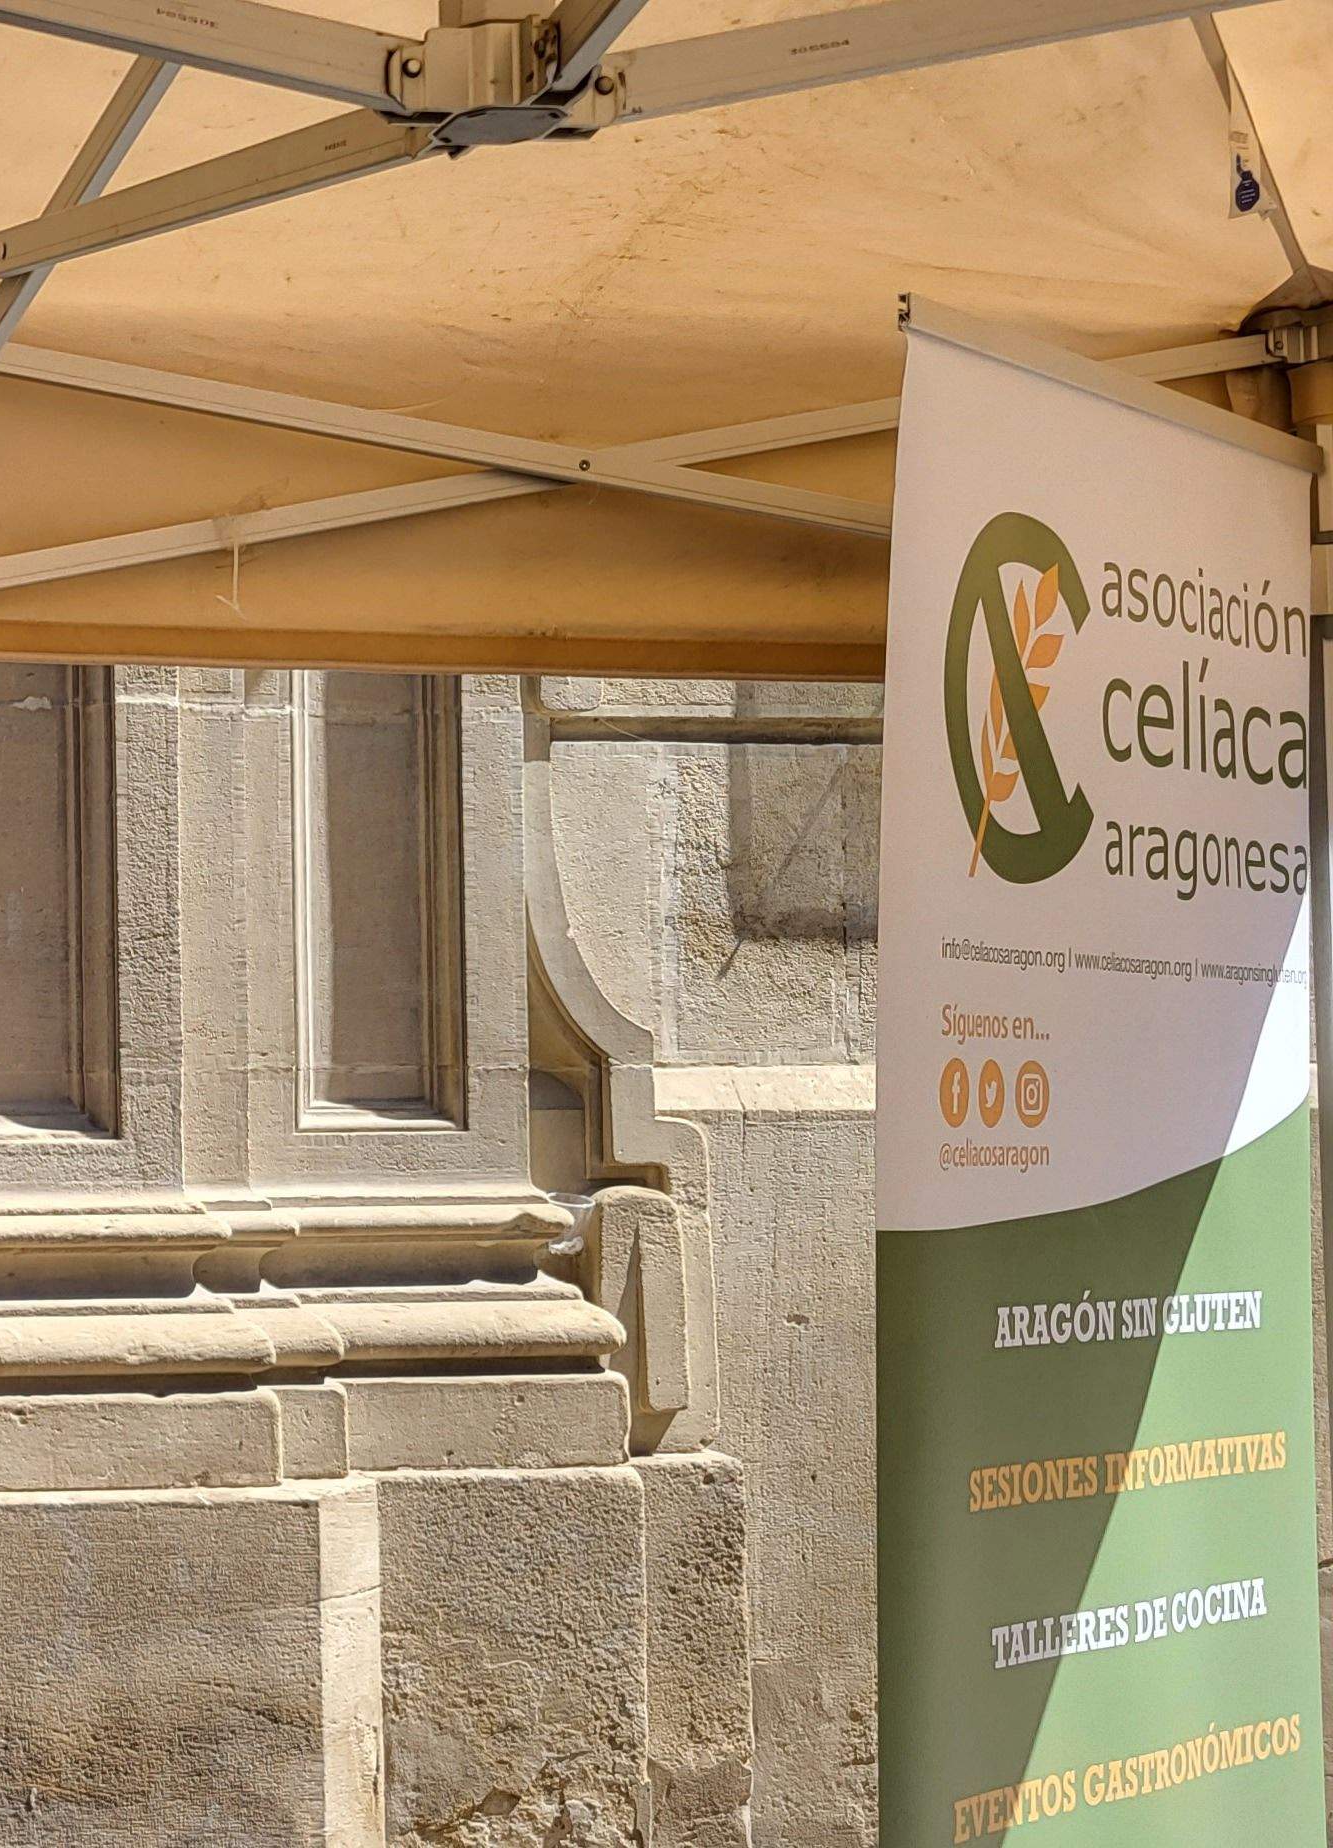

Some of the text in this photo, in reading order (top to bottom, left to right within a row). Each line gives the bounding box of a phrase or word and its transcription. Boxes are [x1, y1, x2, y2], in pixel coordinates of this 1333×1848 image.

[1102, 562, 1306, 657] asociación
[1102, 656, 1307, 789] celíaca
[1105, 820, 1308, 901] aragonesa
[941, 936, 1065, 973] info@celiacosaragon.org
[941, 1003, 1050, 1045] Síguenos en...
[939, 1137, 1050, 1173] @celiacosaragon
[994, 1290, 1262, 1348] ARAGÓN SIN GLUTEN
[969, 1431, 1286, 1512] SESIONES INFORMATIVAS
[991, 1577, 1267, 1669] TALLERES DE COCINA
[953, 1714, 1301, 1845] EVENTOS GASTRONÓMICOS
